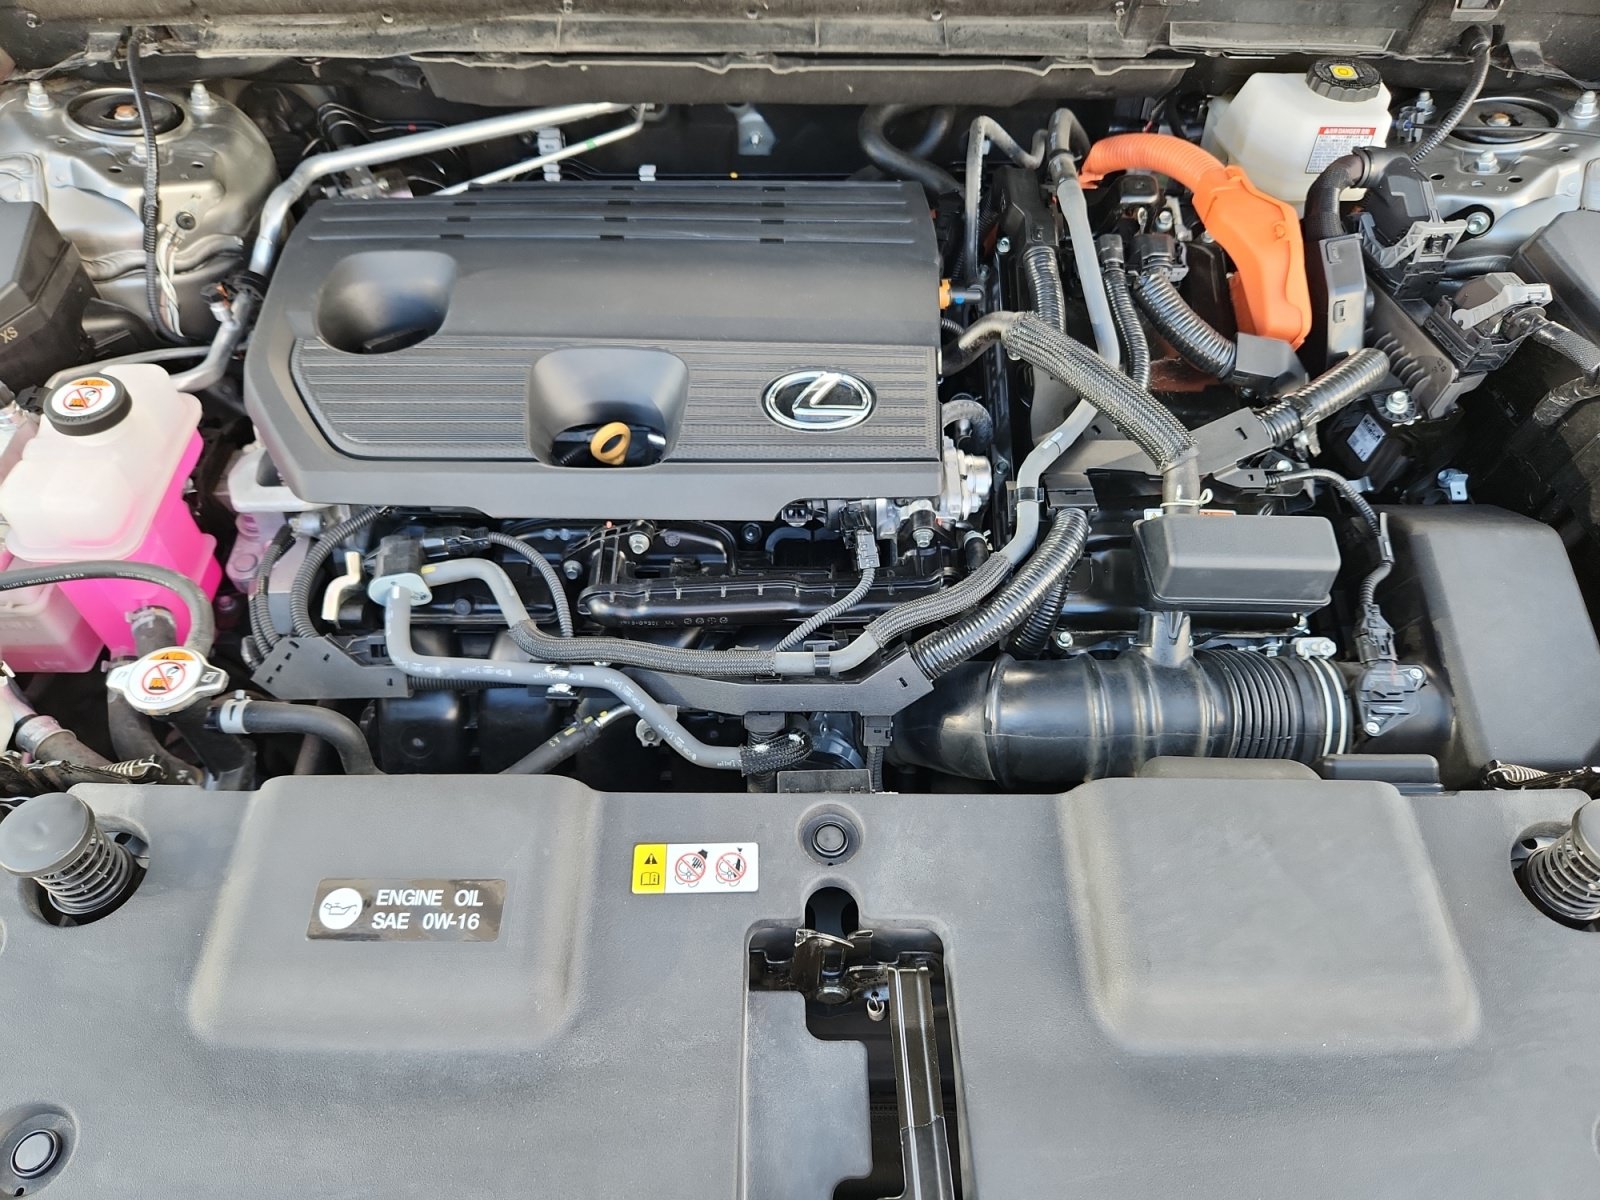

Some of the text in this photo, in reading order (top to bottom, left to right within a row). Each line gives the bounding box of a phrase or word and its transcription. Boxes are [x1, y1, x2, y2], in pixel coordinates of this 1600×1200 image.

[375, 889, 484, 907] ENGINE OIL
[371, 912, 481, 930] SAE 0W-16
